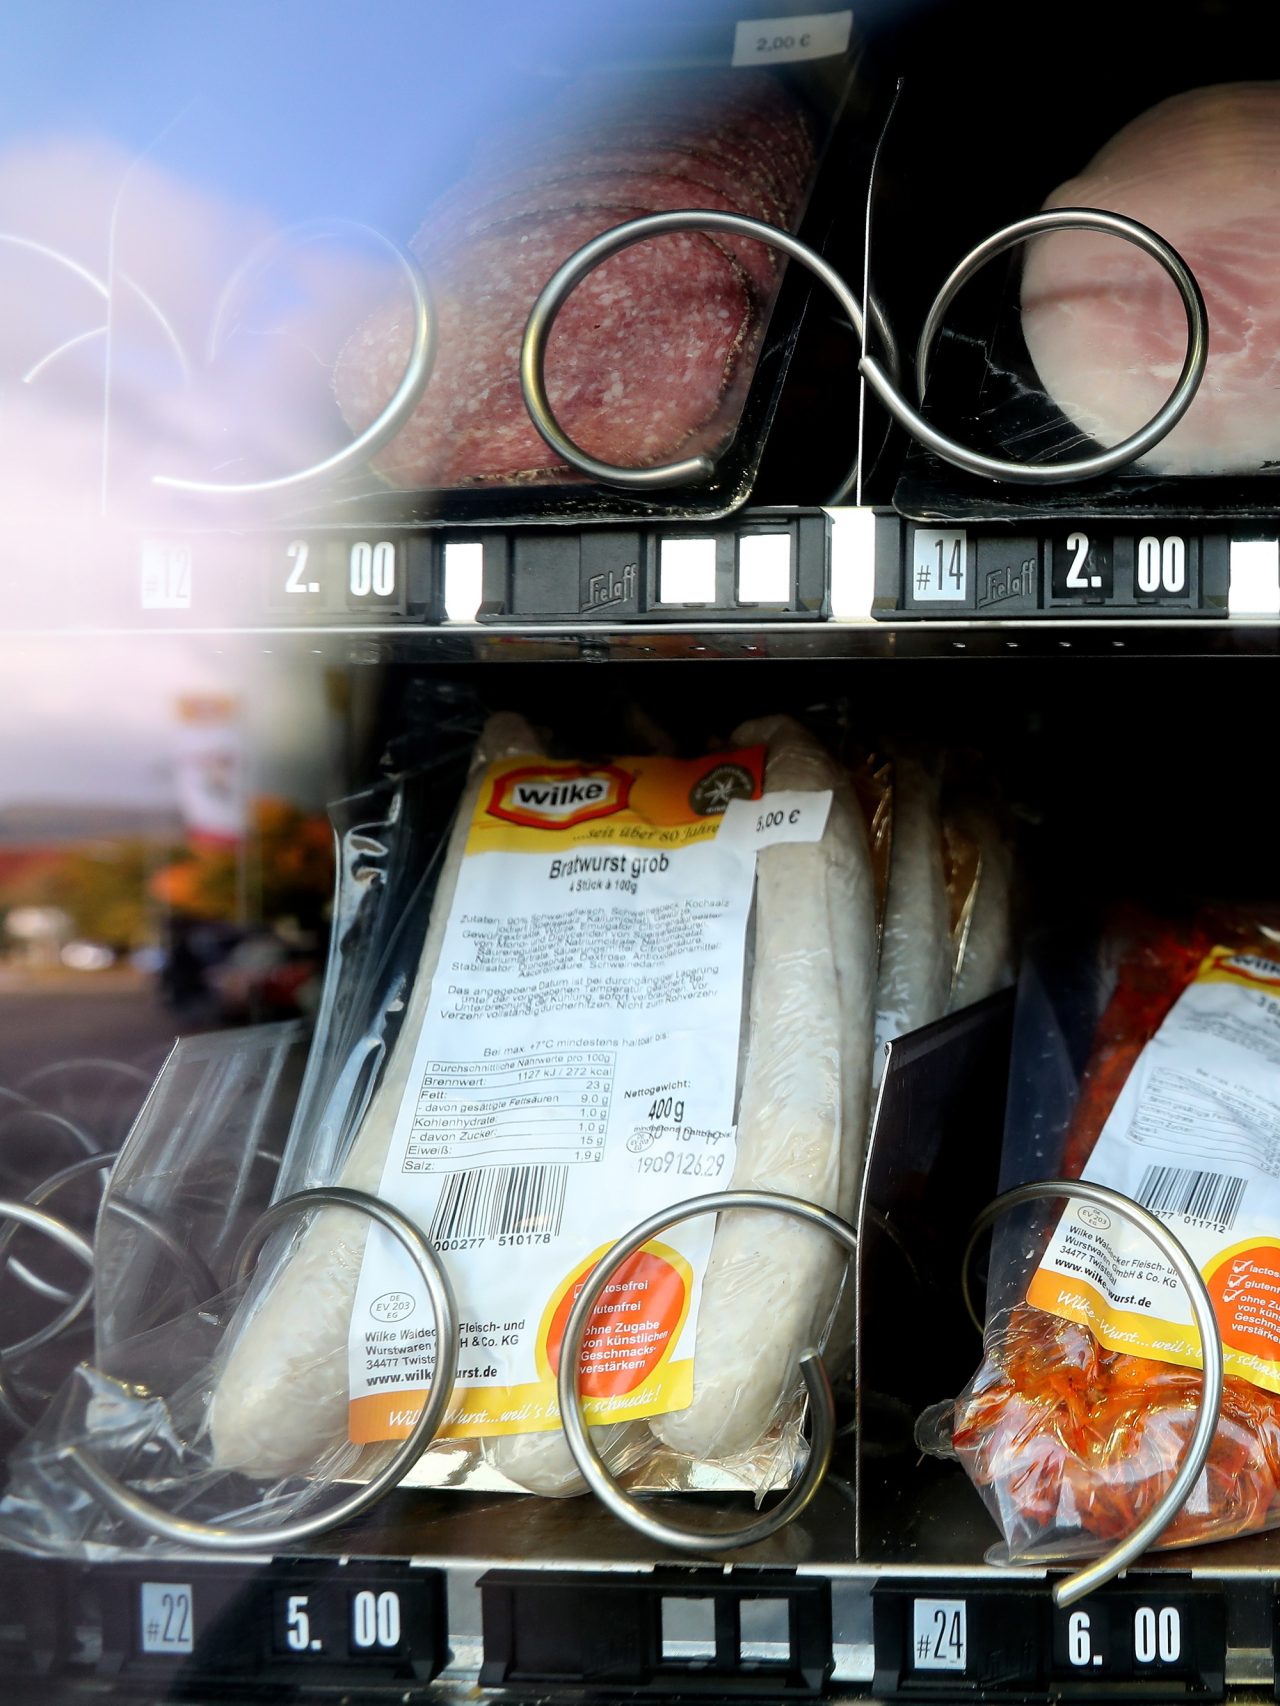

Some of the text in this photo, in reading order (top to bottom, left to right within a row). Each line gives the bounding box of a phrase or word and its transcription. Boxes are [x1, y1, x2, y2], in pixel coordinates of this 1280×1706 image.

[284, 539, 396, 597] 2. 00
[916, 537, 966, 592] #14
[1065, 532, 1186, 594] 2. 00
[143, 549, 189, 599] #12
[549, 852, 670, 880] Bratwurst grob
[576, 879, 602, 893] Stück
[614, 879, 639, 895] 100g
[556, 1037, 619, 1049] mindestens
[566, 1054, 583, 1064] pro
[586, 1053, 611, 1064] 100g
[423, 1076, 487, 1087] Brennwert:
[565, 1067, 587, 1077] 272
[420, 1080, 611, 1100] Fett: 23 g
[623, 1080, 691, 1099] Nettogewicht:
[425, 1102, 458, 1113] davon
[648, 1096, 686, 1123] 400 g
[408, 1144, 452, 1156] Eiweiß:
[580, 1135, 594, 1145] 15
[419, 1131, 457, 1142] davon
[404, 1160, 436, 1171] Salz:
[1183, 1216, 1226, 1234] 011712
[499, 1233, 551, 1247] 510178
[1069, 1224, 1094, 1242] Wilke
[1130, 1259, 1166, 1273] Fleisch-
[1059, 1245, 1088, 1261] 34477
[1064, 1235, 1178, 1290] Wurstwaren GmbH & Co. KG
[602, 1280, 649, 1295] tosefrei
[1054, 1257, 1153, 1309] www.wilke-wurst.de
[376, 1302, 411, 1312] EV 203
[389, 1294, 401, 1302] DE
[1240, 1294, 1267, 1307] ohne
[386, 1311, 398, 1319] EG
[593, 1301, 642, 1315] lutenfrei
[1237, 1304, 1257, 1315] von
[365, 1319, 526, 1342] Wilke Waldec Fleisch- und
[585, 1320, 661, 1336] ohne Zugabe
[365, 1341, 432, 1356] Wurstwaren
[471, 1336, 481, 1347] &
[481, 1336, 498, 1347] Co.
[501, 1334, 519, 1346] KG
[582, 1330, 670, 1349] von künstlichen
[366, 1355, 436, 1371] 34477 Twiste
[580, 1346, 657, 1362] Geschmacks-
[366, 1364, 498, 1387] www.wilkurst.de
[579, 1359, 646, 1375] verstärkern
[146, 1591, 191, 1644] #22
[286, 1590, 401, 1650] 5. 00
[916, 1605, 965, 1662] #24
[1067, 1610, 1103, 1667] 6.
[1132, 1605, 1181, 1664] 00
